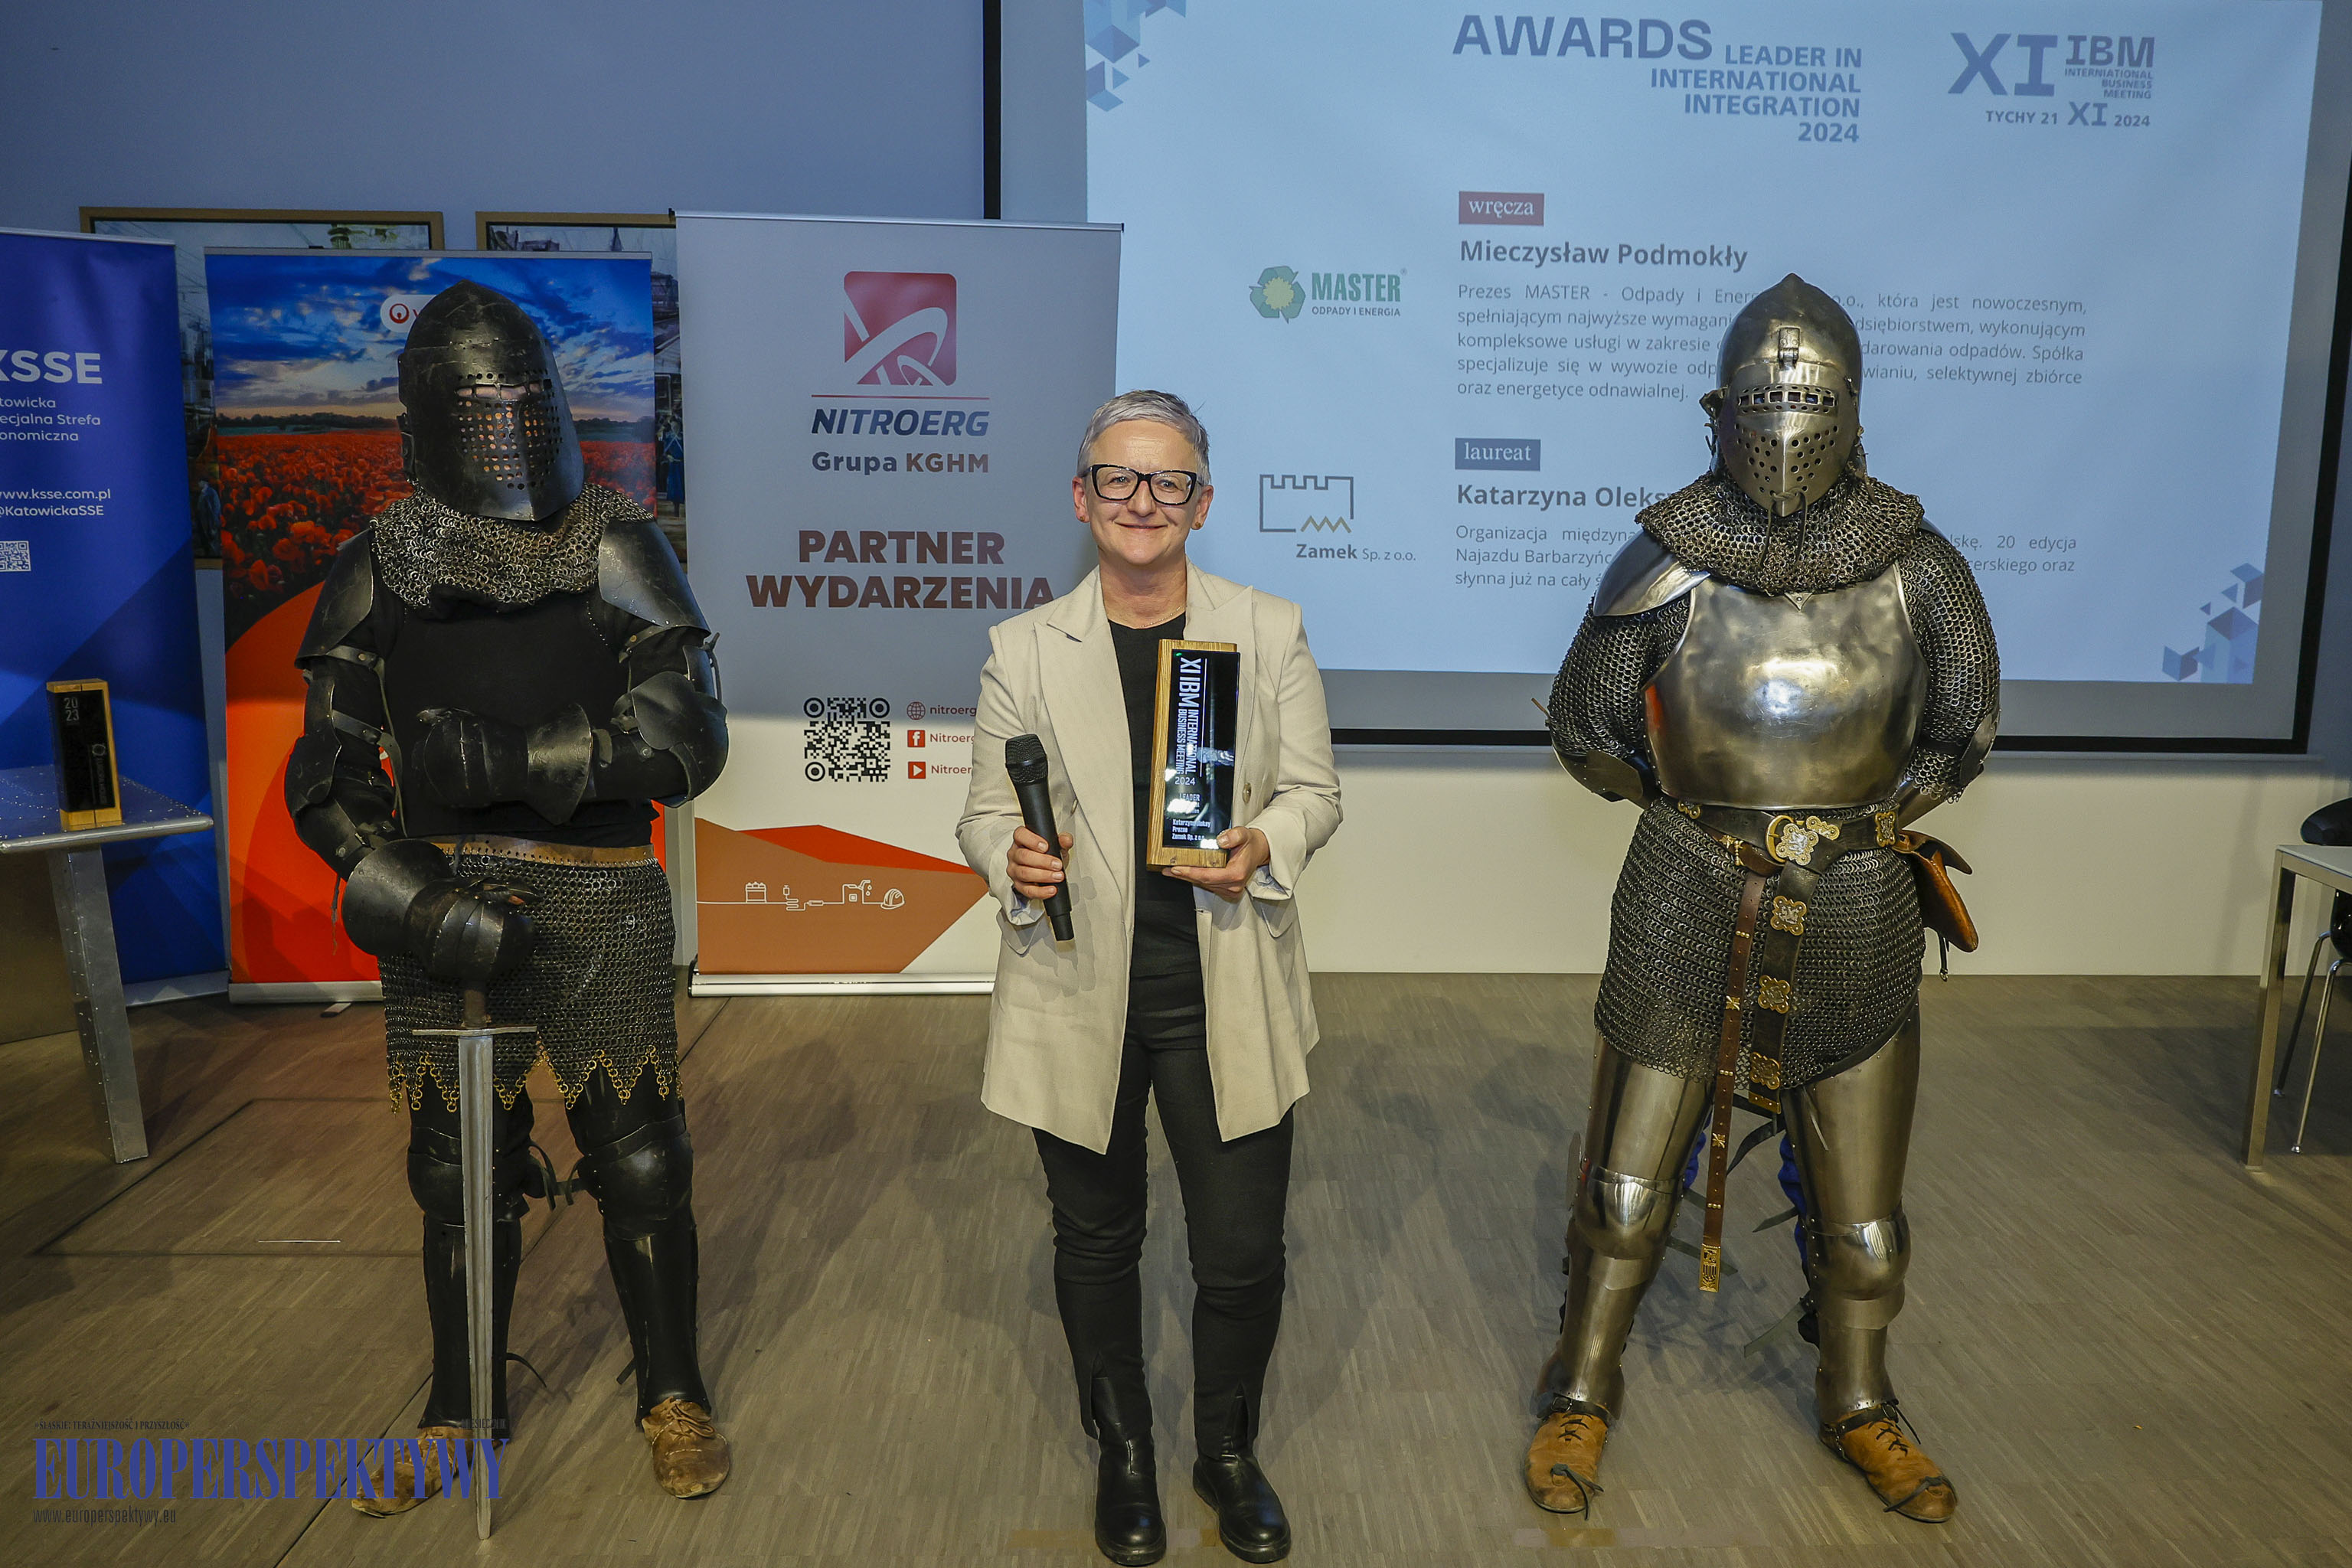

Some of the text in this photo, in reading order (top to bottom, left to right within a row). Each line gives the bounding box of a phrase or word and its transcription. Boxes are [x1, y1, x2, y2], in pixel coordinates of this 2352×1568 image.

[1453, 15, 1712, 60] AWARDS
[1725, 44, 1862, 67] LEADER IN
[1948, 32, 2154, 97] XI IBM
[1651, 68, 1861, 93] INTERNATIONAL
[2102, 79, 2152, 90] BUSINESS
[1684, 94, 1860, 117] INTEGRATION
[2103, 89, 2151, 100] MEETING
[1985, 101, 2151, 127] TYCHY 21 XI 2024
[1798, 122, 1859, 143] 2024
[1468, 199, 1534, 218] wręcza
[1460, 240, 1748, 273] Mieczysław Podmokły
[1312, 272, 1401, 302] MASTER
[1459, 284, 1511, 300] Prezes
[1525, 284, 1590, 300] MASTER
[1622, 286, 1684, 304] Odpady
[1878, 293, 1919, 308] która
[1930, 294, 1960, 312] jest
[1972, 296, 2087, 315] nowoczesnym,
[1312, 306, 1351, 315] ODPADY
[1359, 307, 1401, 317] ENERGIA
[1457, 308, 1562, 325] spełniającym
[1567, 309, 1647, 328] najwyższe
[1980, 318, 2086, 339] wykonującym
[1458, 332, 1568, 351] kompleksowe
[1574, 335, 1621, 353] usługi
[1626, 338, 1641, 350] w
[1646, 336, 1710, 351] zakresie
[1862, 341, 1942, 357] darowania
[1949, 342, 2026, 360] odpadów.
[2032, 345, 2083, 363] Spółka
[1457, 357, 1548, 375] specjalizuje
[1557, 359, 1579, 375] się
[1589, 361, 1602, 372] w
[1611, 360, 1678, 377] wywozie
[1926, 365, 2017, 386] selektywnej
[2026, 369, 2082, 384] zbiórce
[1457, 381, 1689, 400] oraz energetyce odnawialnej.
[57, 413, 101, 426] Strefa
[812, 408, 989, 436] NITROERG
[1464, 442, 1532, 461] laureat
[812, 452, 989, 475] Grupa KGHM
[0, 488, 111, 501] ww.ksse.com.pl
[1457, 484, 1671, 511] Katarzyna Oleks
[799, 530, 1004, 565] PARTNER
[1455, 524, 1547, 544] Organizacja
[1997, 535, 2015, 549] 20
[2029, 536, 2076, 553] edycja
[1295, 544, 1416, 562] Zamek Sp. z o.o.
[1455, 548, 1519, 565] Najazdu
[2042, 560, 2076, 572] oraz
[746, 575, 1054, 609] WYDARZENIA
[1455, 571, 1505, 588] słynna
[1509, 572, 1532, 588] już
[1537, 574, 1556, 586] na
[1560, 573, 1592, 590] cały
[1178, 657, 1201, 707] XI IBM
[64, 697, 79, 710] 20
[65, 709, 80, 721] 23
[929, 704, 976, 717] nitroerg
[1175, 708, 1187, 775] BUSINESS MEETING
[1174, 776, 1196, 786] 2024
